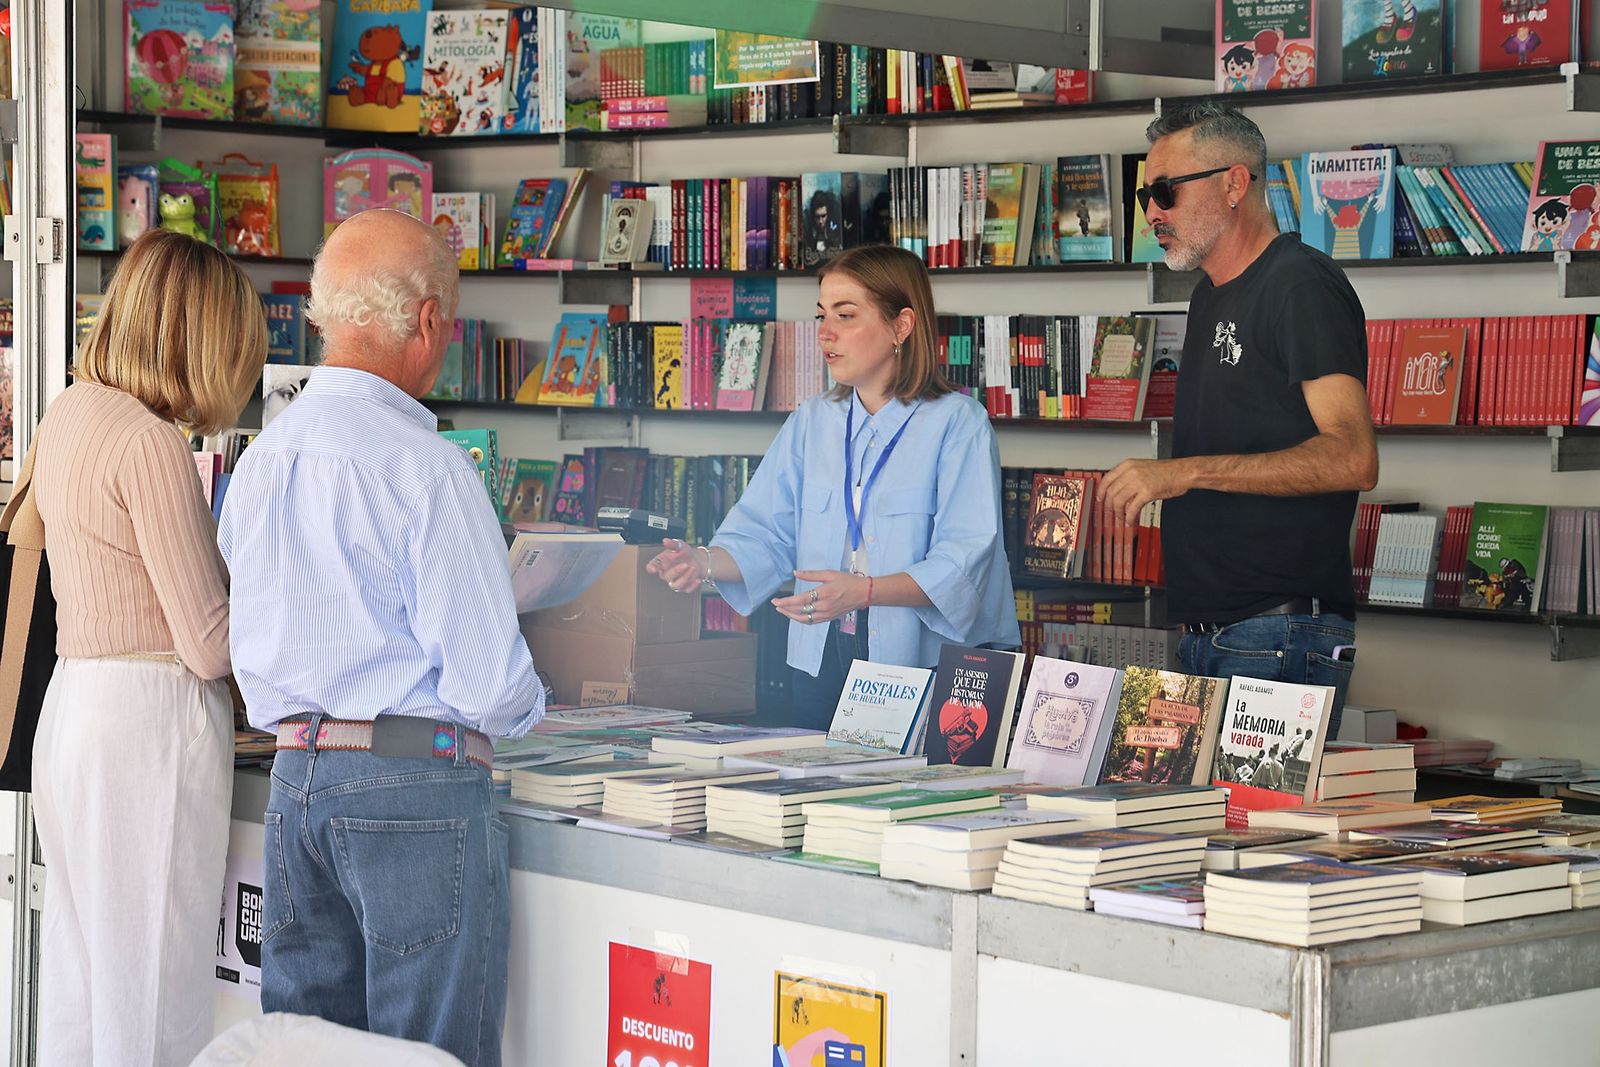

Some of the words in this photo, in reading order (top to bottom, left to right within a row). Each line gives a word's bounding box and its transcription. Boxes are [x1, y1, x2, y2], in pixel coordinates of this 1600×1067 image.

[1237, 6, 1253, 17] DE
[1256, 4, 1296, 16] BESOS
[583, 25, 621, 40] AGUA
[1555, 146, 1582, 158] UNA
[1311, 156, 1387, 174] ¡MAMITETA!
[1557, 160, 1573, 170] DE
[1477, 533, 1501, 542] DONDE
[1476, 542, 1500, 550] QUEDA
[1475, 550, 1491, 558] VIDA
[964, 670, 989, 680] ASESINO
[852, 678, 918, 700] POSTALES
[953, 676, 971, 688] QUE
[972, 678, 987, 690] LEE
[1239, 684, 1254, 693] RAFAEL
[1255, 686, 1274, 695] ADAMUZ
[848, 692, 859, 700] DE
[860, 694, 886, 706] HUELVA
[951, 687, 985, 700] HISTORIAS
[949, 696, 959, 706] DE
[960, 698, 983, 710] AMOR
[1235, 699, 1247, 713] La
[1232, 713, 1286, 737] MEMORIA
[1230, 731, 1264, 748] varada
[622, 1016, 694, 1051] DESCUENTO
